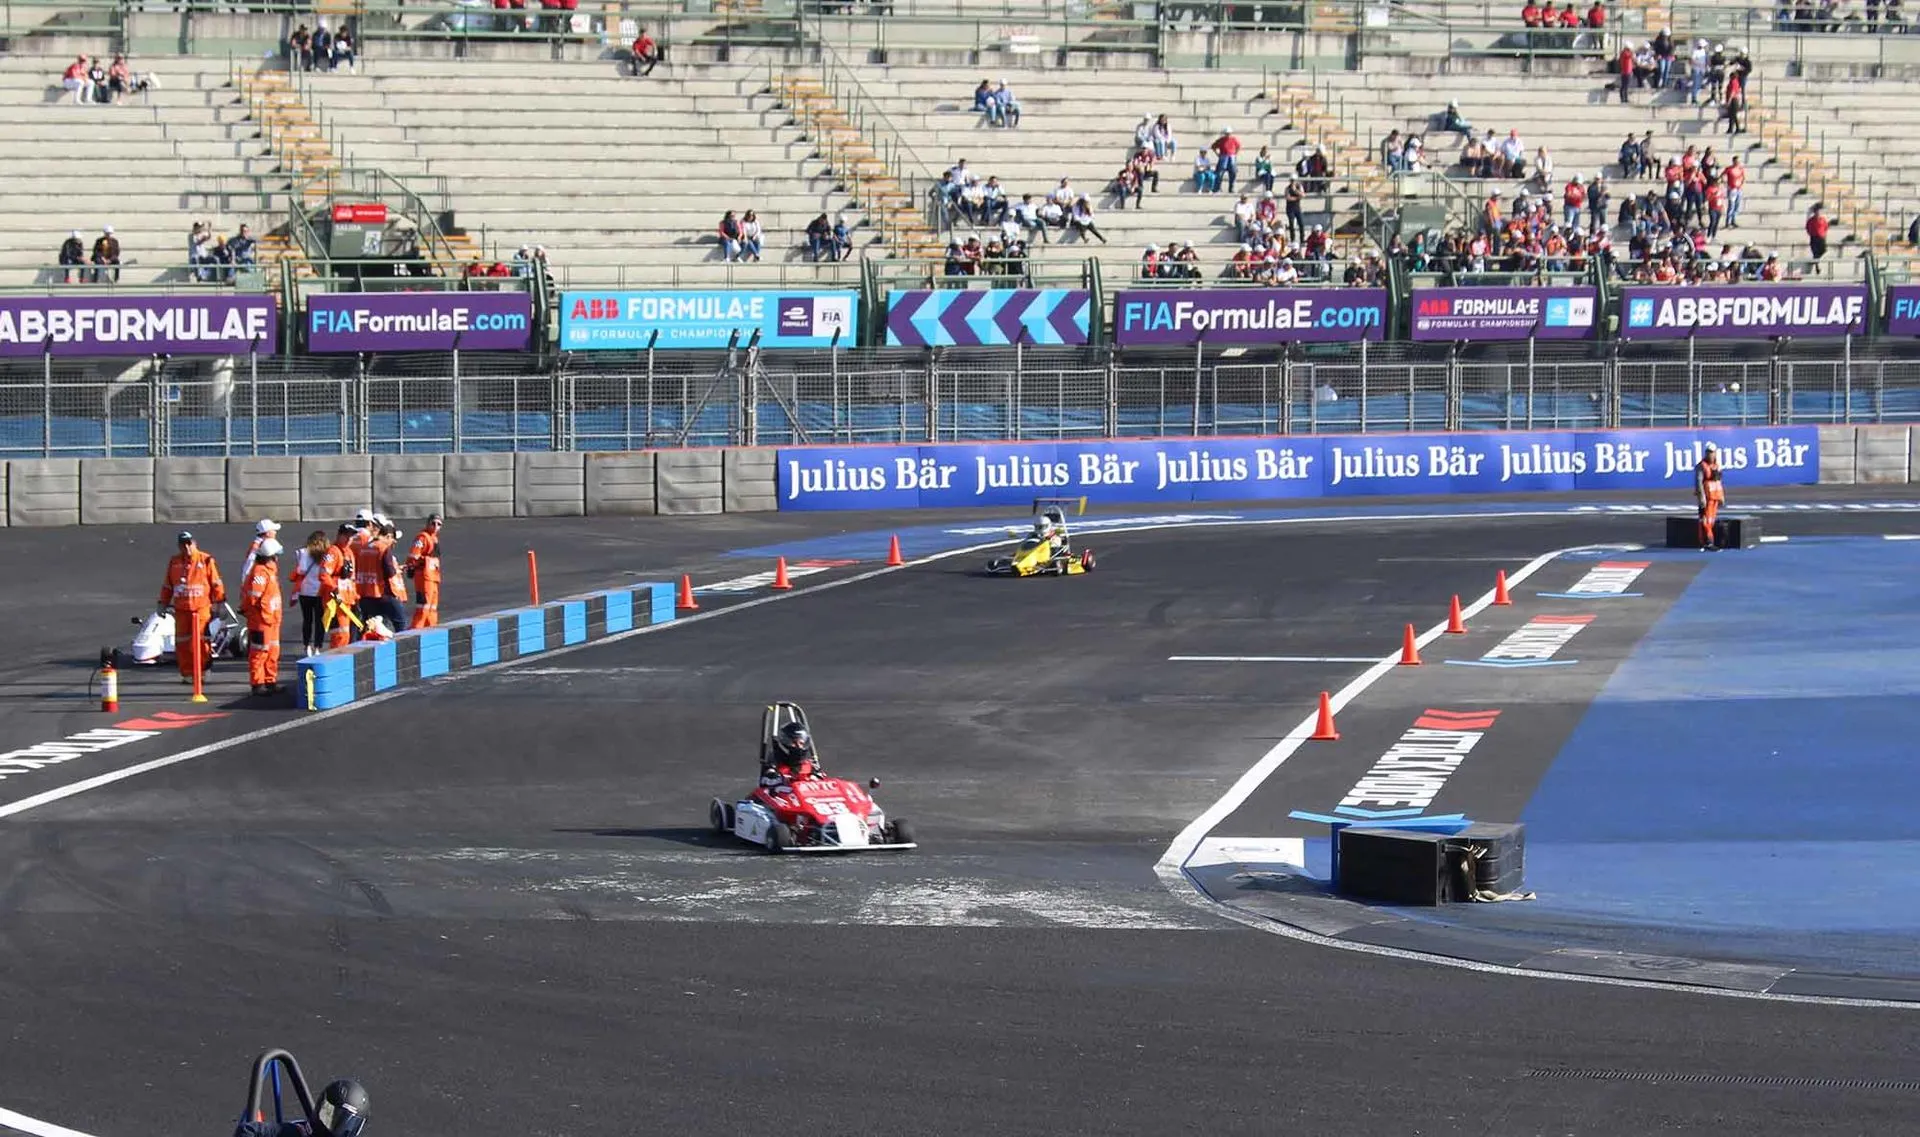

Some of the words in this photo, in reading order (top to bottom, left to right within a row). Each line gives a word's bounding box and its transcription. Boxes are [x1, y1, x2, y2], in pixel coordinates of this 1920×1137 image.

[311, 308, 526, 334] FIAFormulaE.com
[570, 299, 620, 320] ABB
[1124, 300, 1380, 332] FIAFormulaE.com
[789, 460, 885, 499] Julius
[895, 455, 957, 490] Bär
[975, 454, 1070, 496] Julius
[1078, 453, 1141, 485] Bär
[1156, 450, 1248, 490] Julius
[1254, 448, 1314, 481] Bär
[1332, 446, 1421, 484] Julius
[1427, 444, 1486, 477] Bär
[1501, 443, 1587, 482] Julius
[1593, 442, 1650, 474] Bär
[1663, 440, 1748, 479] Julus
[1754, 436, 1810, 468] Bär
